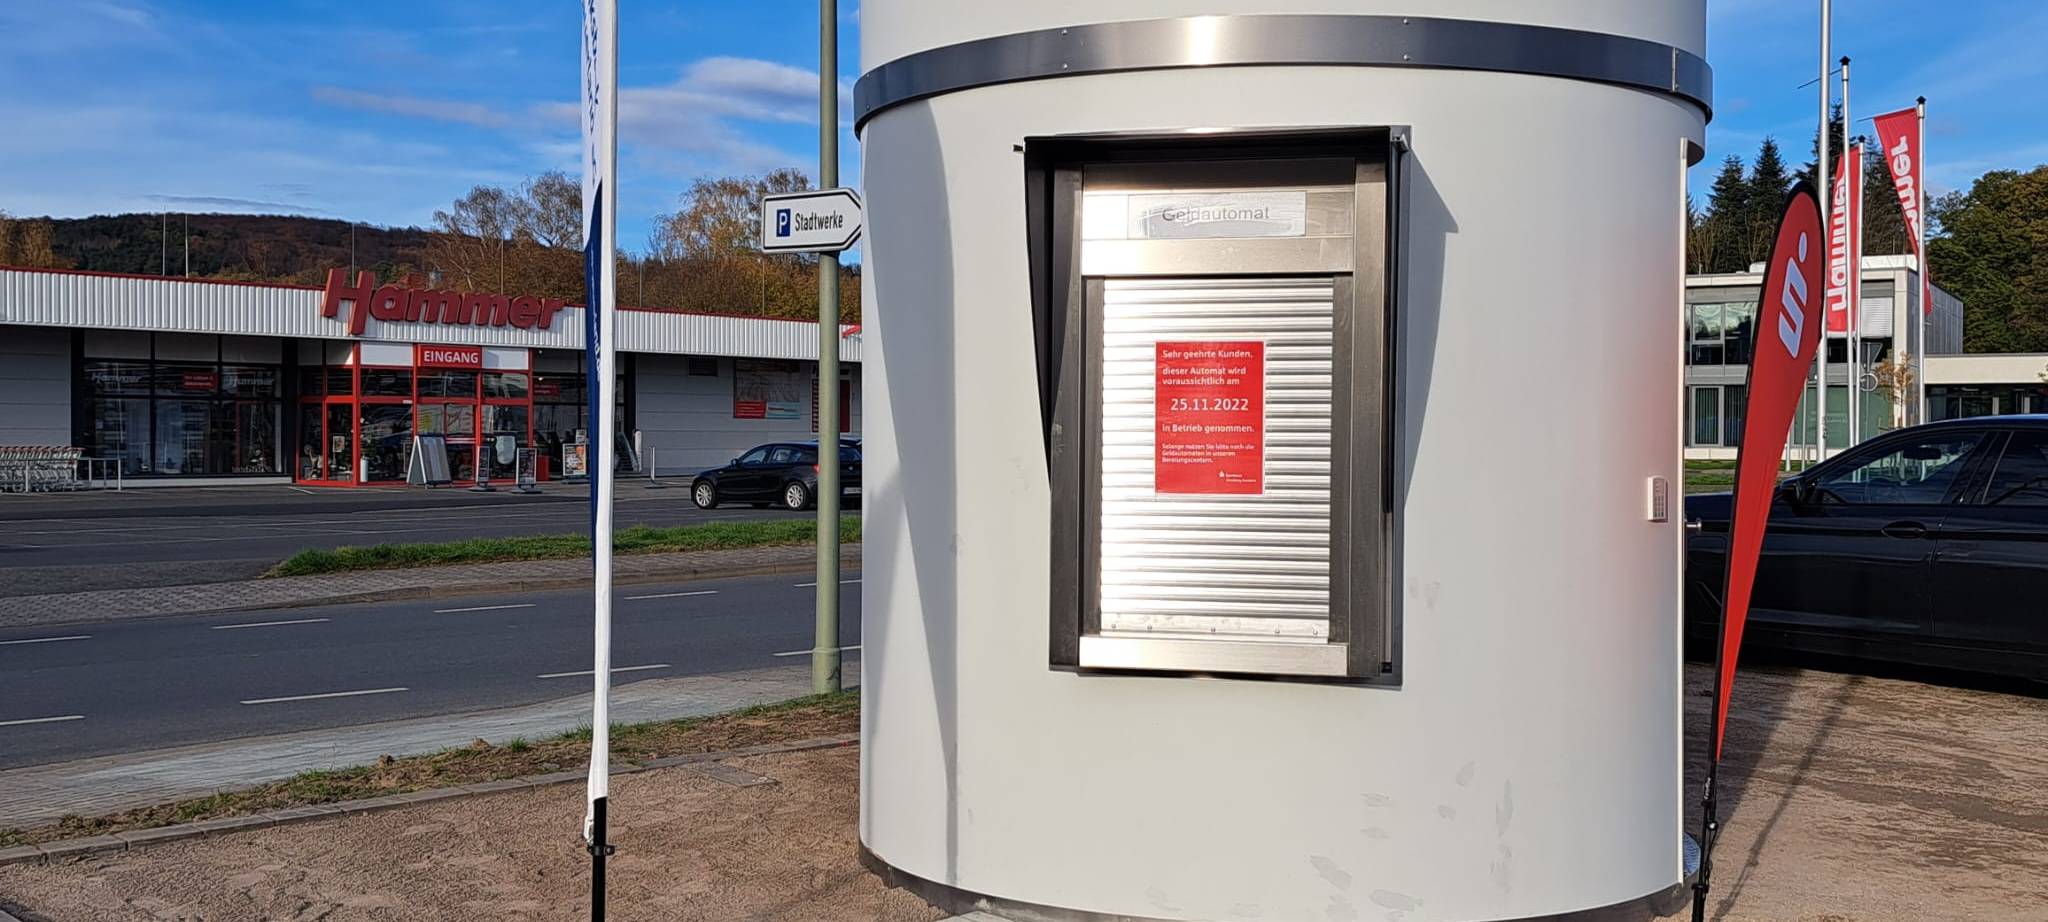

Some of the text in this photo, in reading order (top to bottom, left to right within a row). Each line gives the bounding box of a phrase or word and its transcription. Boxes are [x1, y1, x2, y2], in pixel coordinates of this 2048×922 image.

[794, 210, 844, 232] Stadtwerke
[1162, 207, 1270, 222] Geldautomat
[320, 268, 568, 336] Hammer
[423, 350, 480, 364] EINGANG
[1162, 350, 1253, 359] Sehr geehrte Kunden,
[1162, 367, 1247, 375] dieser Automat wird
[1162, 376, 1225, 385] voraussichtlich
[1170, 398, 1249, 411] 25.11.2022
[1162, 424, 1255, 434] in Betrieb genommen.
